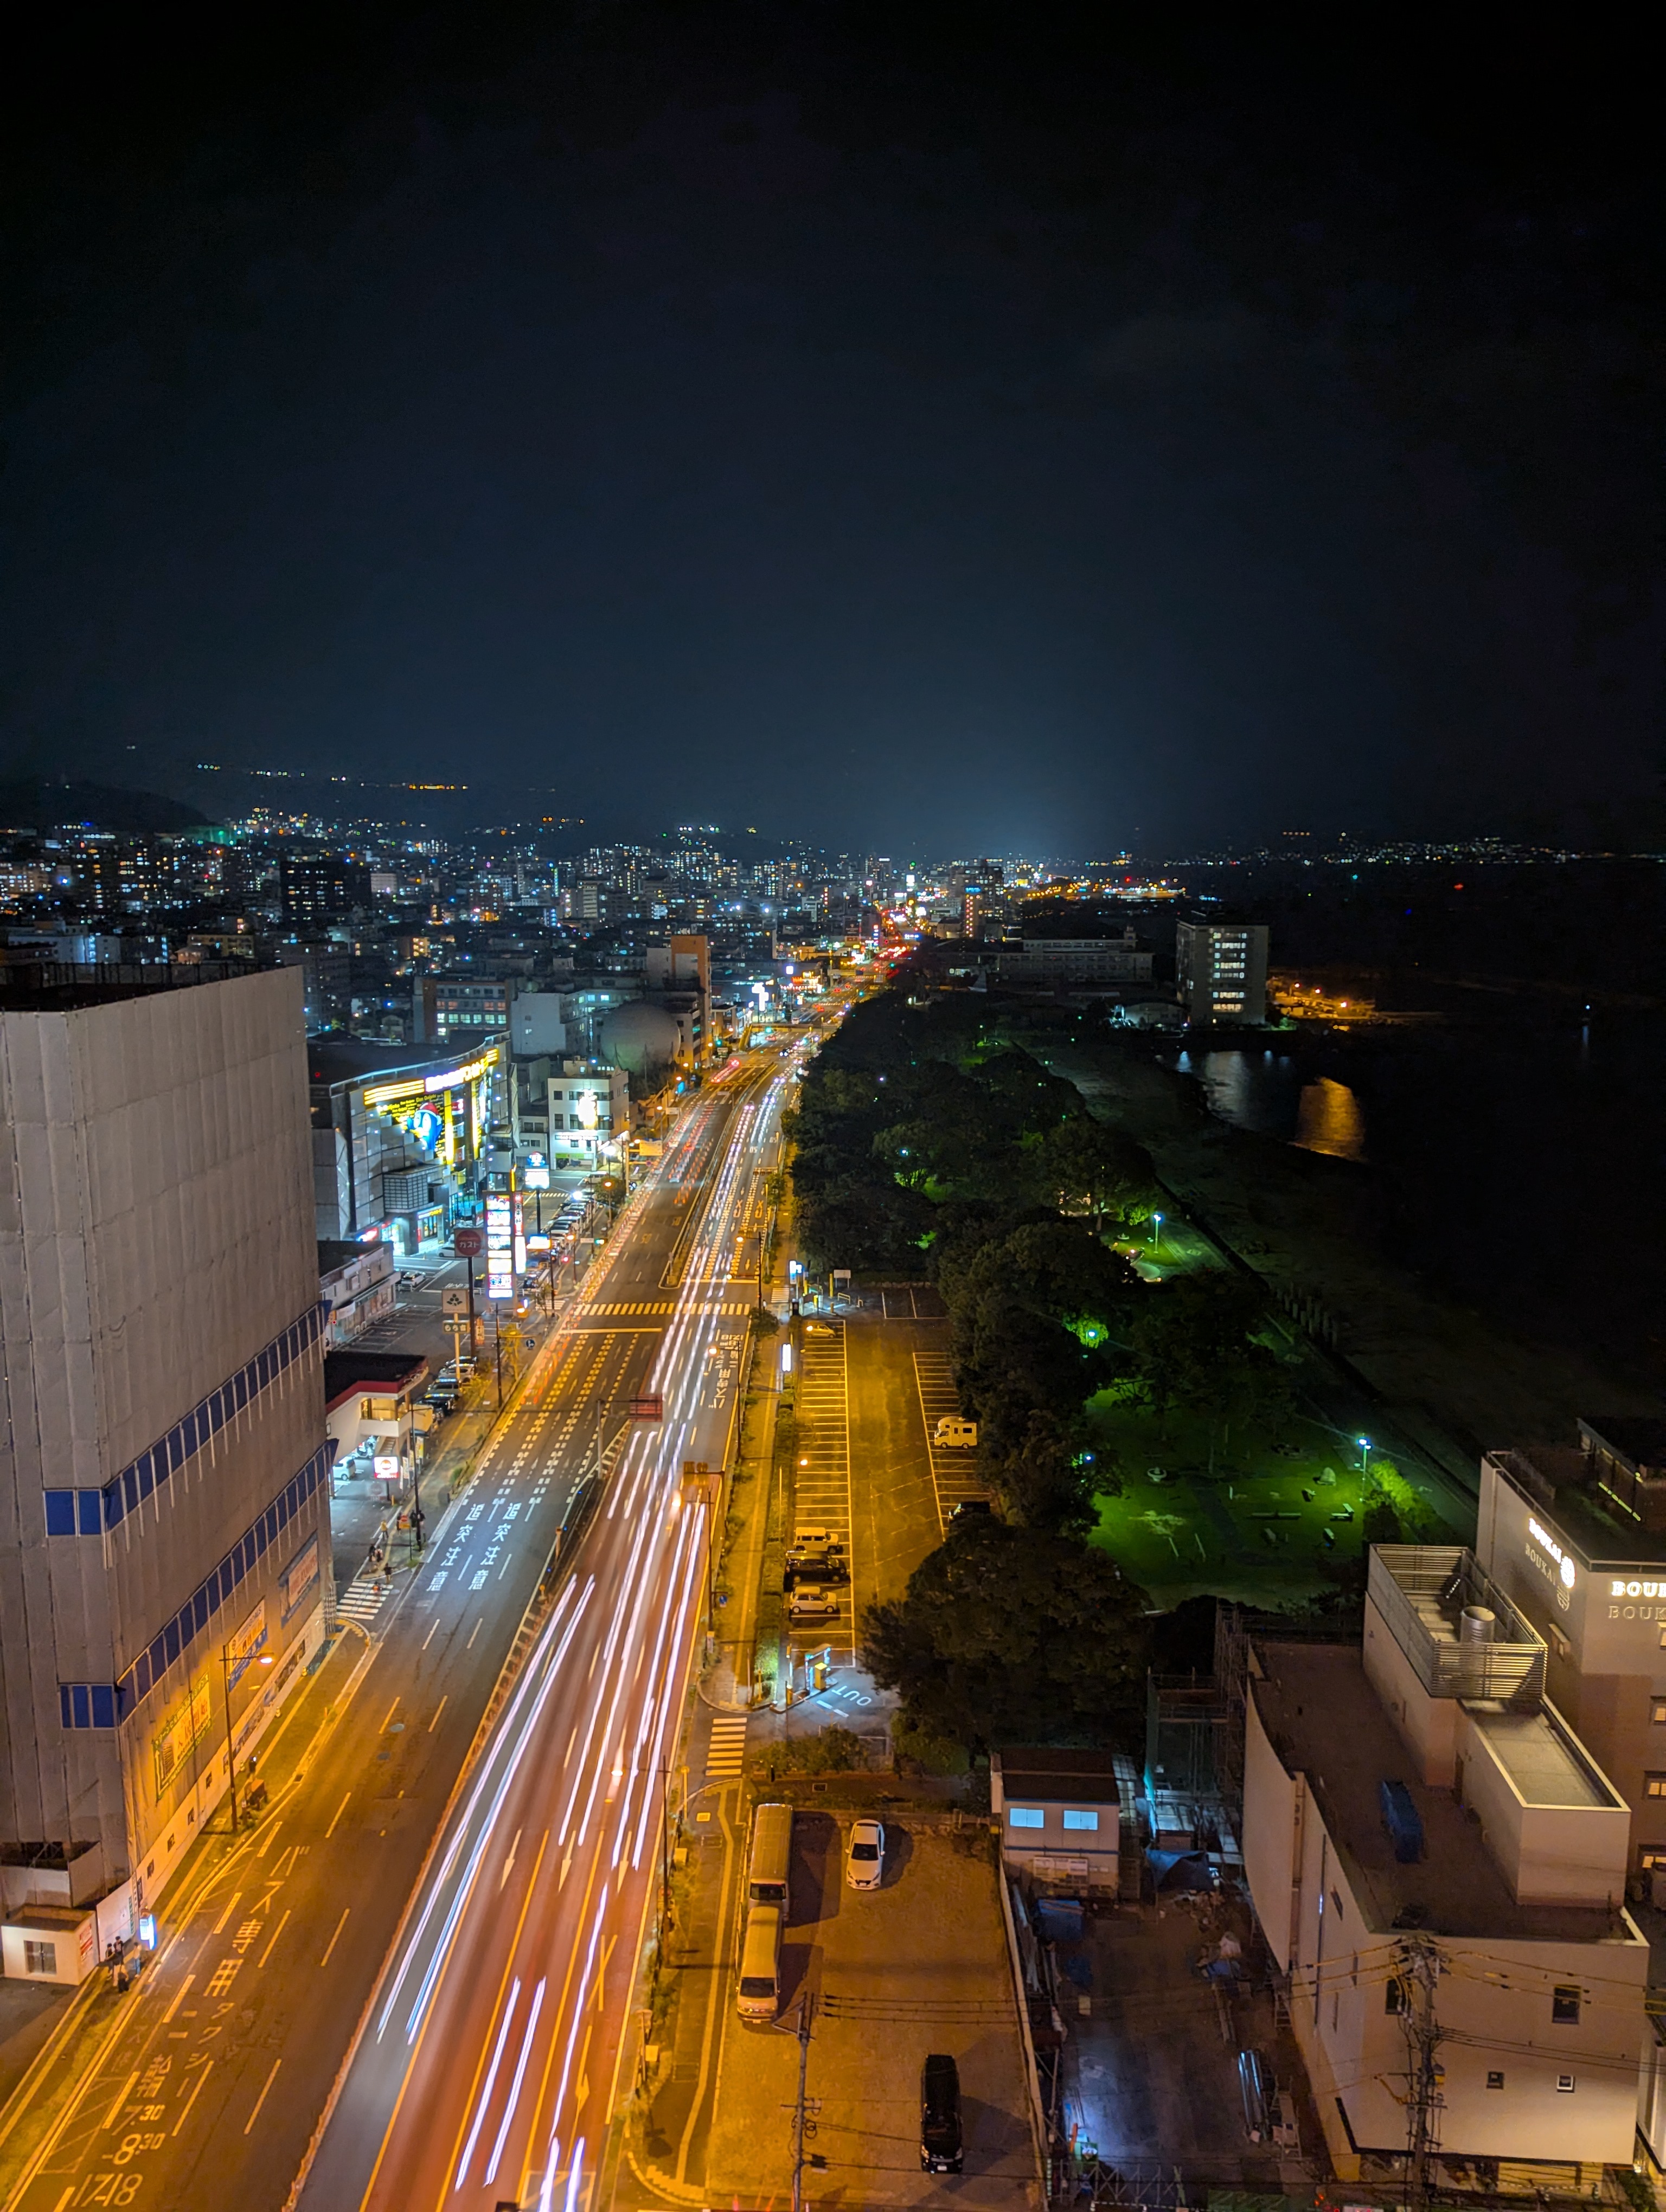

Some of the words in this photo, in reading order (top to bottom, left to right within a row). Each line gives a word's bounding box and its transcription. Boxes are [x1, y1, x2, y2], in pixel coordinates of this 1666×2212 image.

[640, 1233, 652, 1244] 50
[708, 1368, 731, 1409] バス専用
[426, 1503, 485, 1592] 追突注意
[468, 1502, 522, 1591] 追突注意
[1608, 1605, 1666, 1620] BOUK
[831, 1685, 872, 1706] OUT
[203, 1846, 311, 1997] バス専用
[72, 2172, 143, 2207] 17-18
